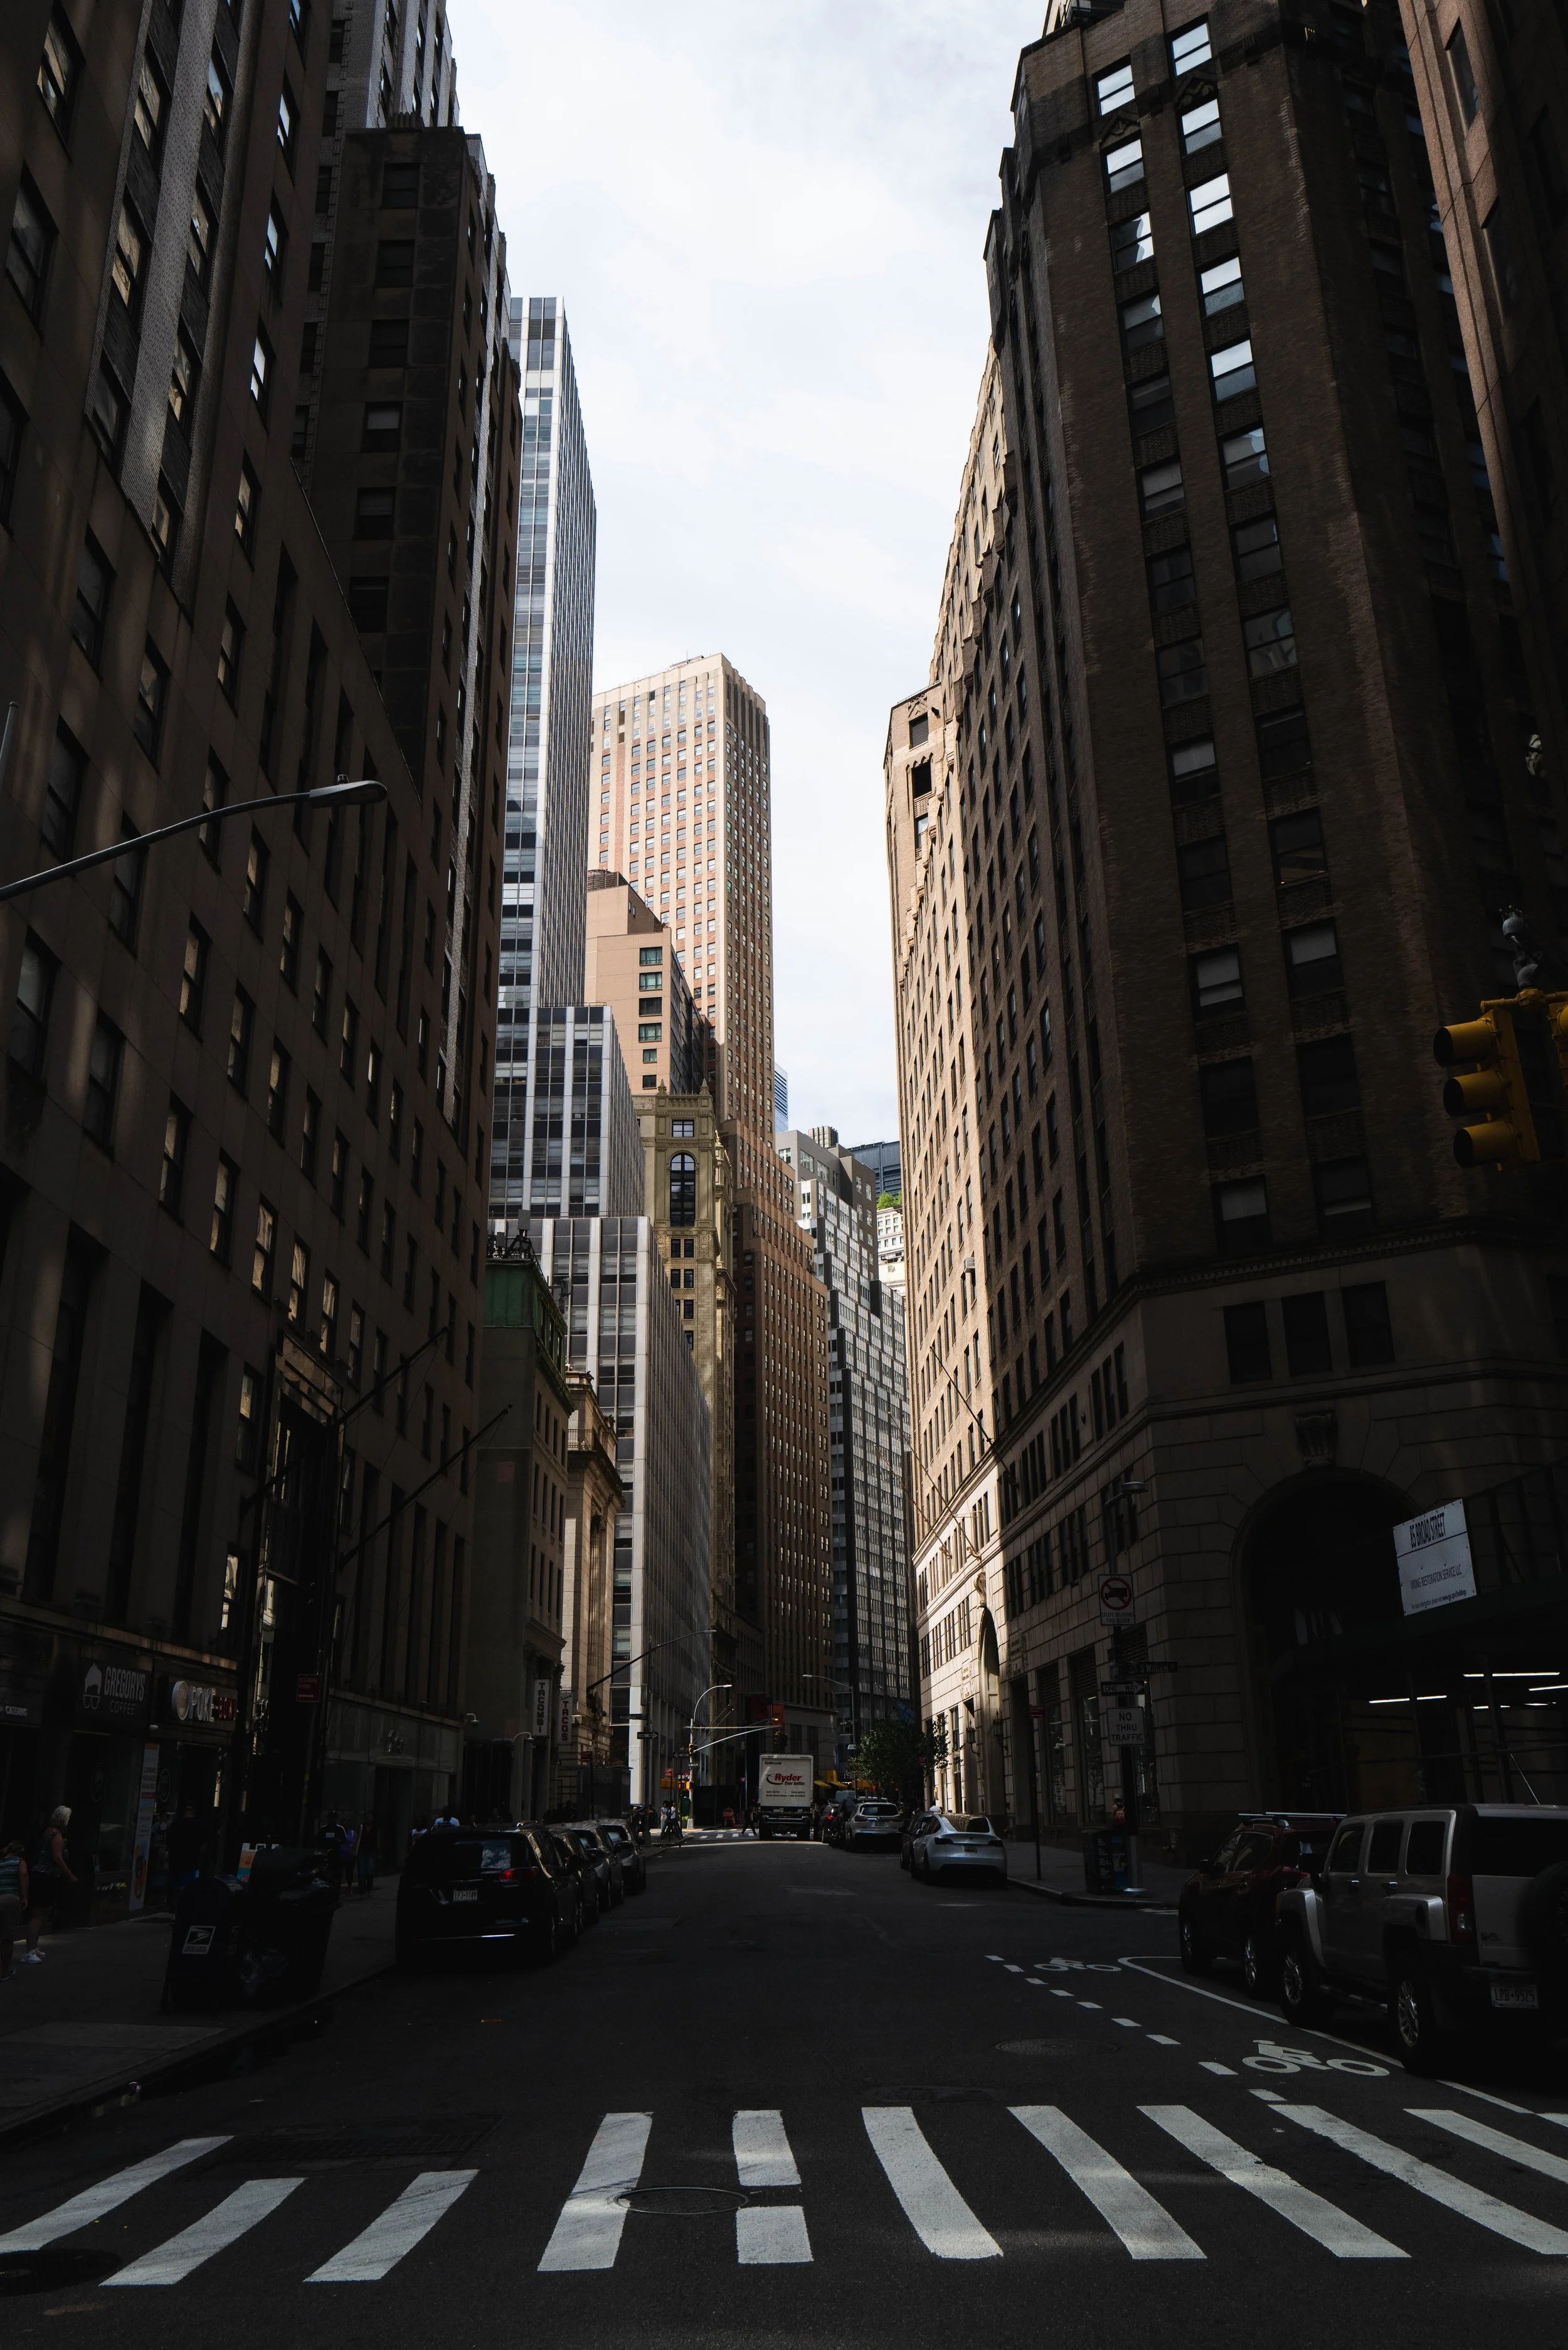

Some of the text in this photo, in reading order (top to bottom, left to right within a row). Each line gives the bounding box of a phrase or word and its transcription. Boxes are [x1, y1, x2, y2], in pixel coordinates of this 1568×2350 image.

[1409, 1512, 1446, 1548] 85 BROAD STREET
[1421, 1571, 1443, 1587] RESTORATION
[1443, 1566, 1456, 1580] SERVICE
[104, 1666, 146, 1701] GREGORYS
[1124, 1683, 1139, 1691] WAY
[110, 1700, 135, 1715] COFFEE
[188, 1686, 216, 1722] POKE
[536, 1682, 546, 1733] TACOMBI
[1119, 1712, 1131, 1721] NO
[1116, 1723, 1137, 1732] THRU
[1111, 1733, 1143, 1742] TRAFFIC
[775, 1773, 802, 1783] Ryder
